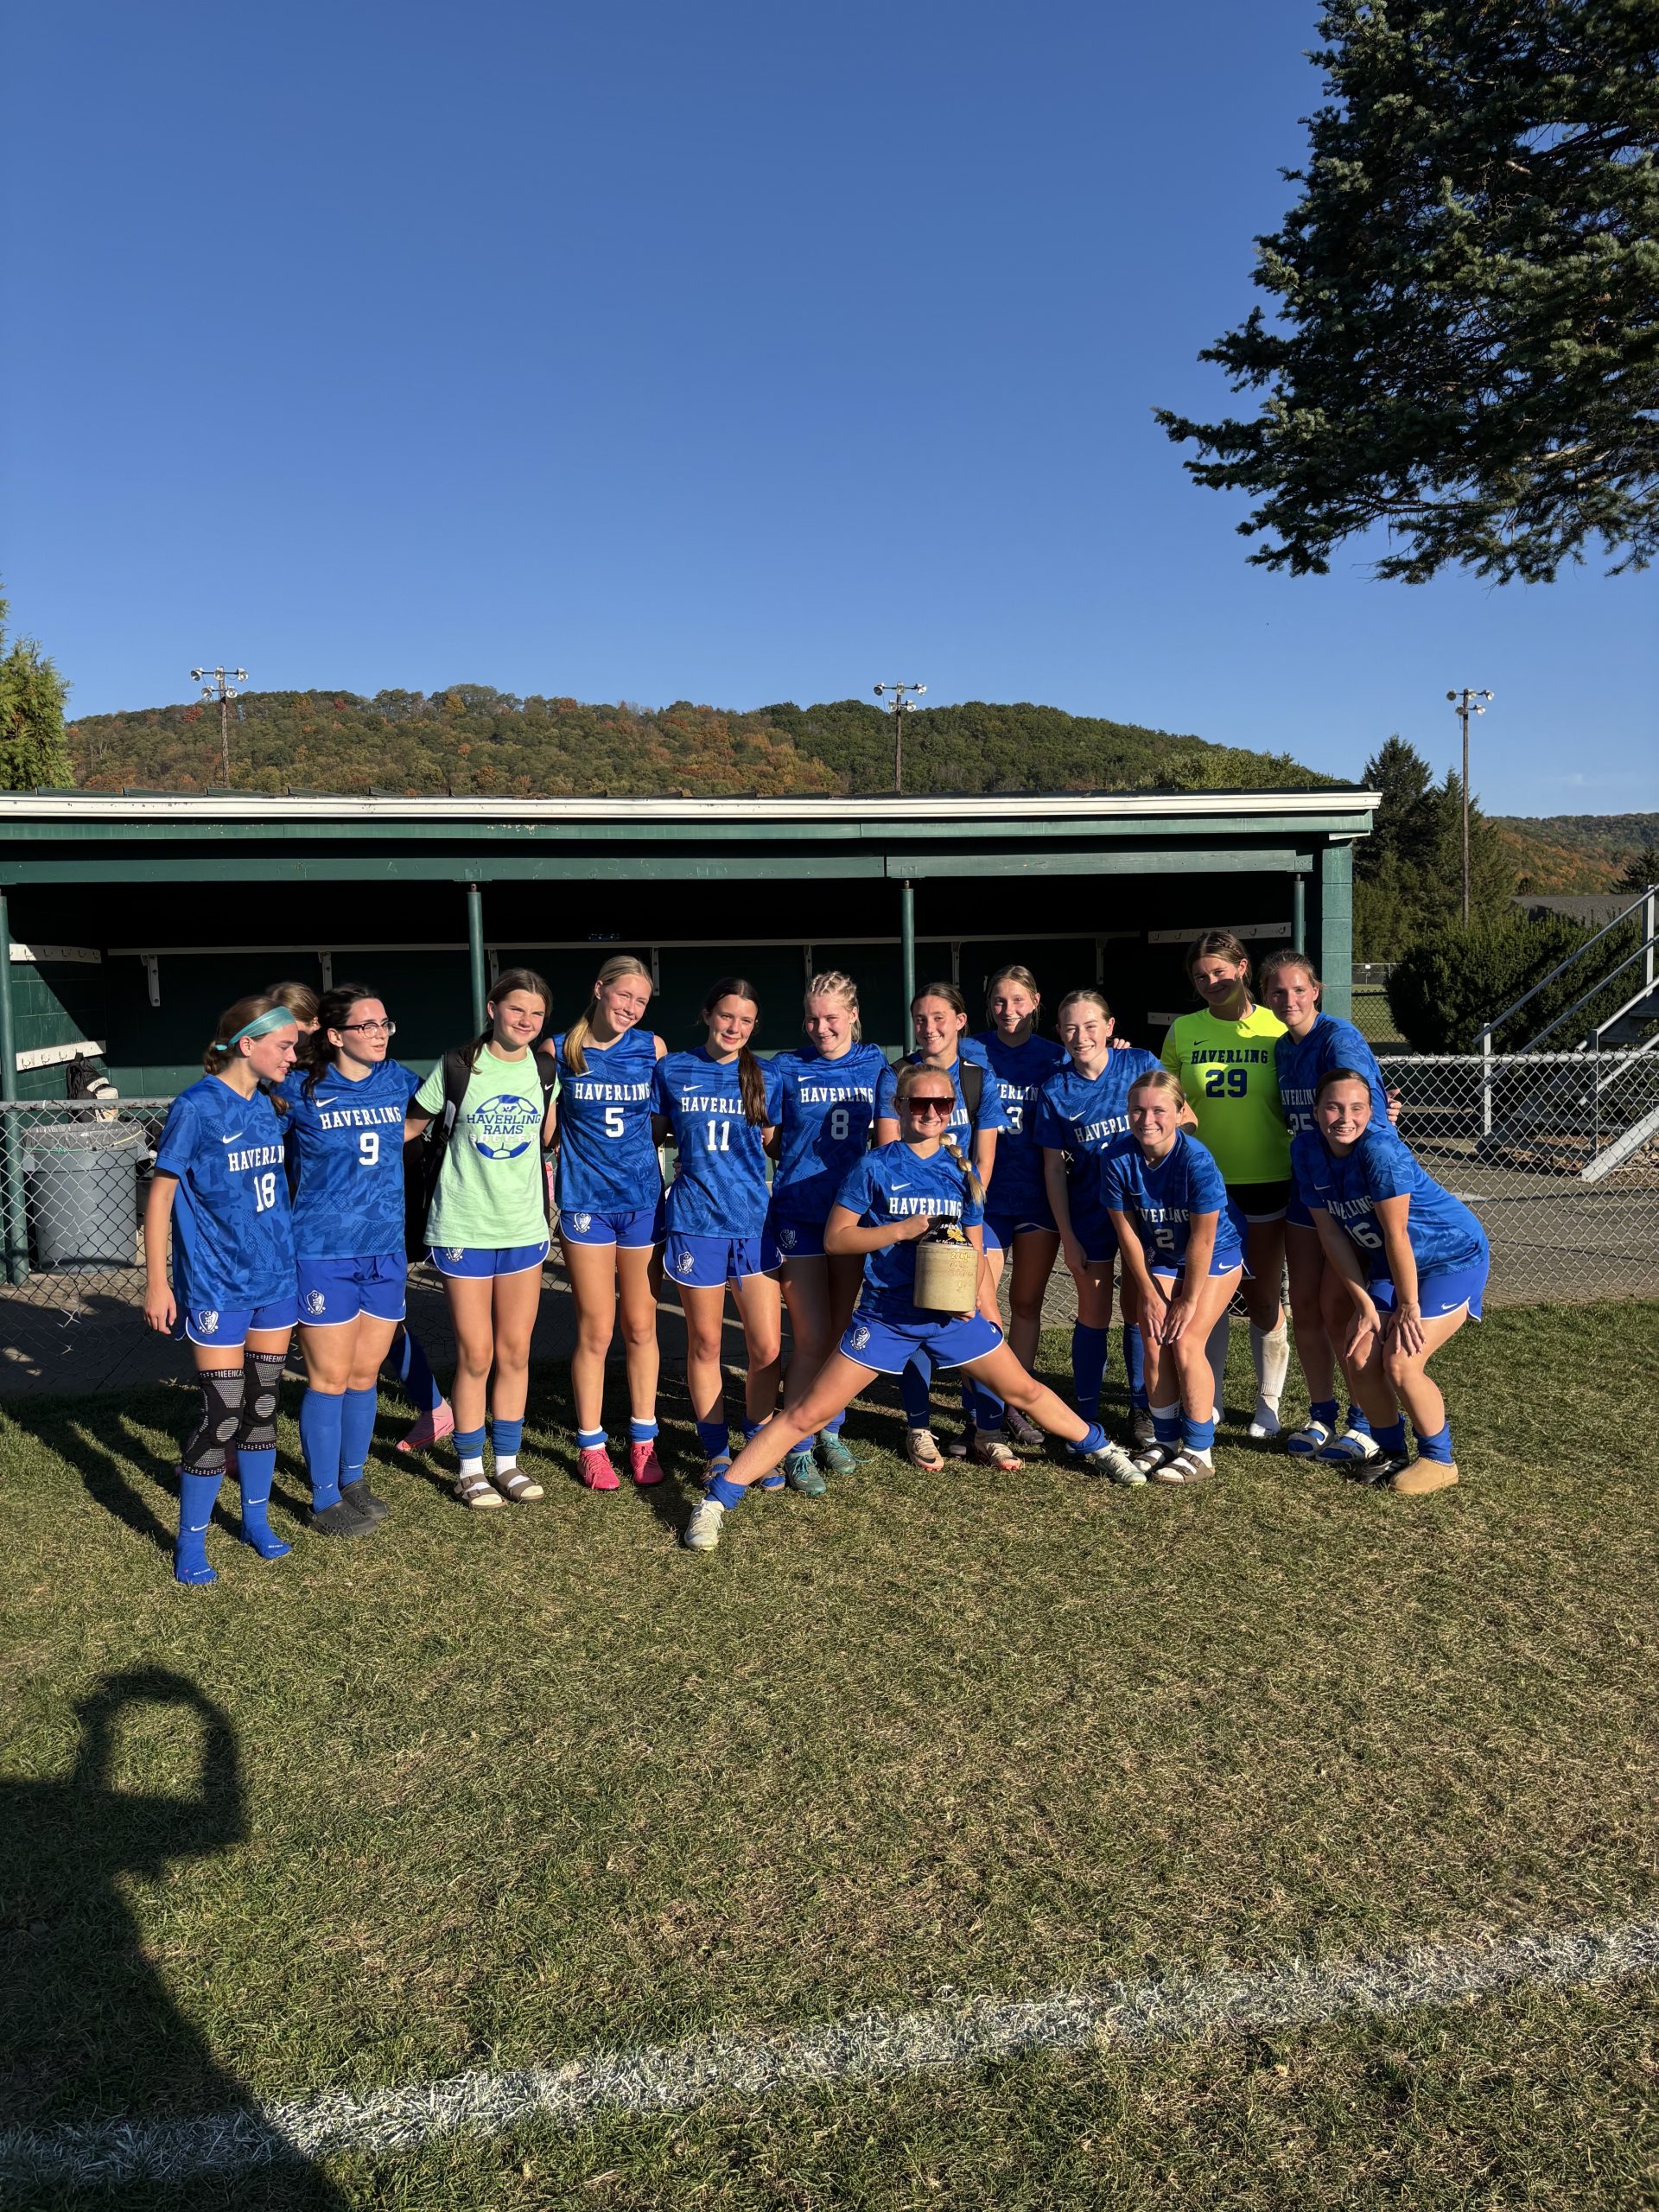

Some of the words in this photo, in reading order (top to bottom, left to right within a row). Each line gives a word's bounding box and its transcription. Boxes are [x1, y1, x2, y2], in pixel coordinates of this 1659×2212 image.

[1191, 1049, 1268, 1065] HAVERLING
[574, 1083, 651, 1102] HAVERLING
[996, 1084, 1039, 1102] ERLIN
[1205, 1068, 1247, 1097] 29
[681, 1096, 746, 1116] HAVERLI
[800, 1087, 874, 1103] HAVERLING
[1280, 1089, 1317, 1106] AVERLIN
[319, 1106, 402, 1130] HAVERLING
[467, 1114, 541, 1125] HAVERLING
[605, 1107, 625, 1138] 5
[831, 1109, 849, 1140] 8
[1073, 1115, 1131, 1143] HAVERLI
[484, 1125, 524, 1135] RAMS
[707, 1120, 730, 1151] 11
[227, 1145, 285, 1172] HAVERLI
[359, 1132, 379, 1166] 9
[253, 1172, 276, 1212] 18
[888, 1197, 962, 1219] HAVERLING
[1154, 1228, 1175, 1250] 2
[1344, 1222, 1382, 1249] 16
